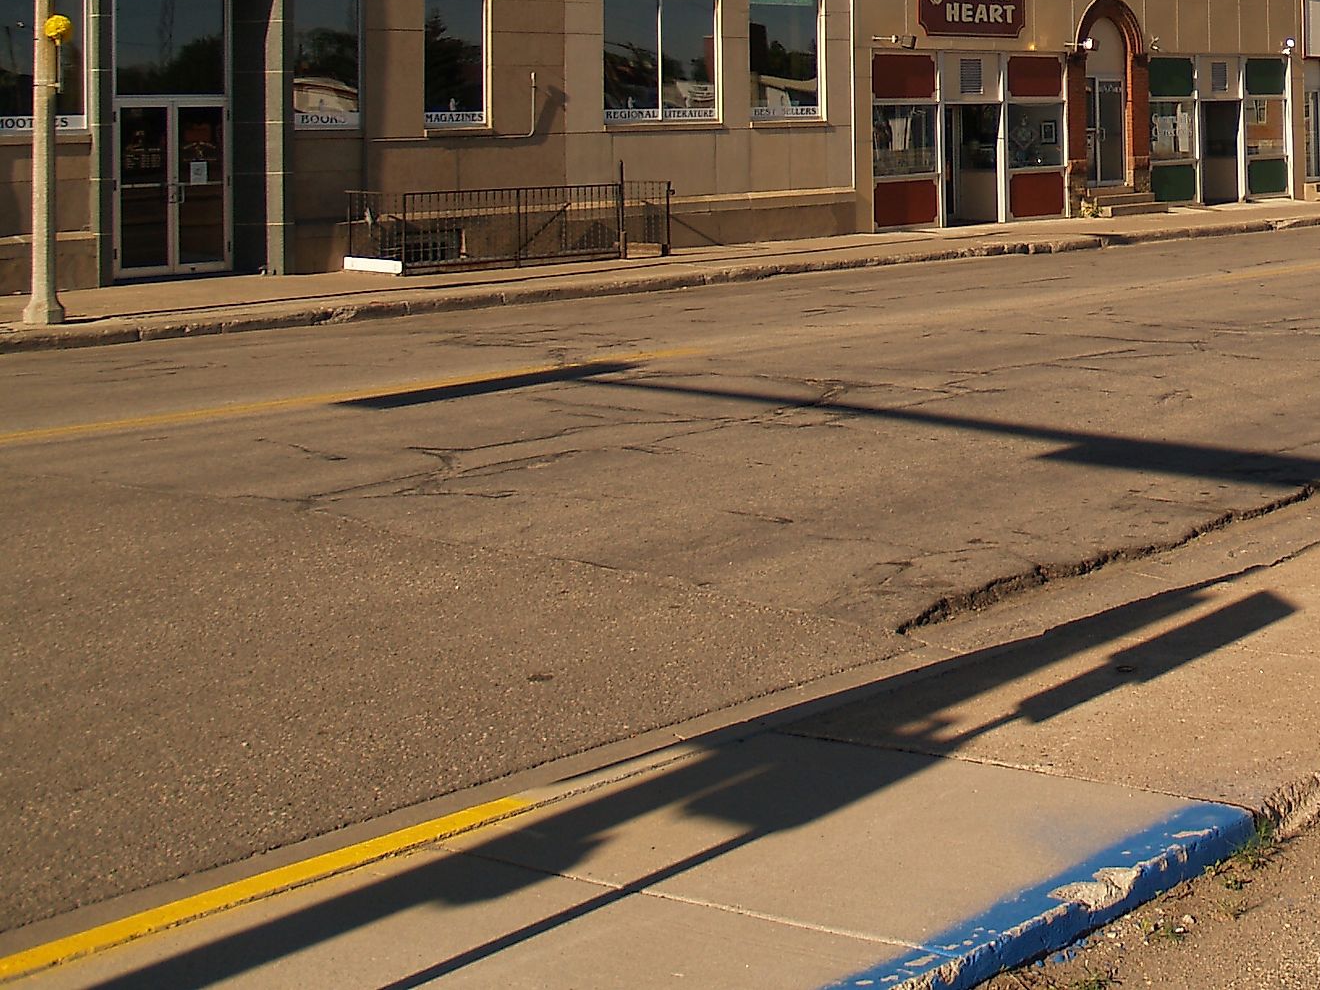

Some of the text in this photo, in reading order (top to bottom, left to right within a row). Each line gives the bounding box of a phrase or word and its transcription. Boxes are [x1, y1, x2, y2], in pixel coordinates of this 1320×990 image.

[945, 2, 1016, 24] HEART
[606, 109, 714, 120] REGIONAL LITERATURE
[783, 107, 817, 116] ELLERS
[425, 112, 484, 123] MAGAZINES
